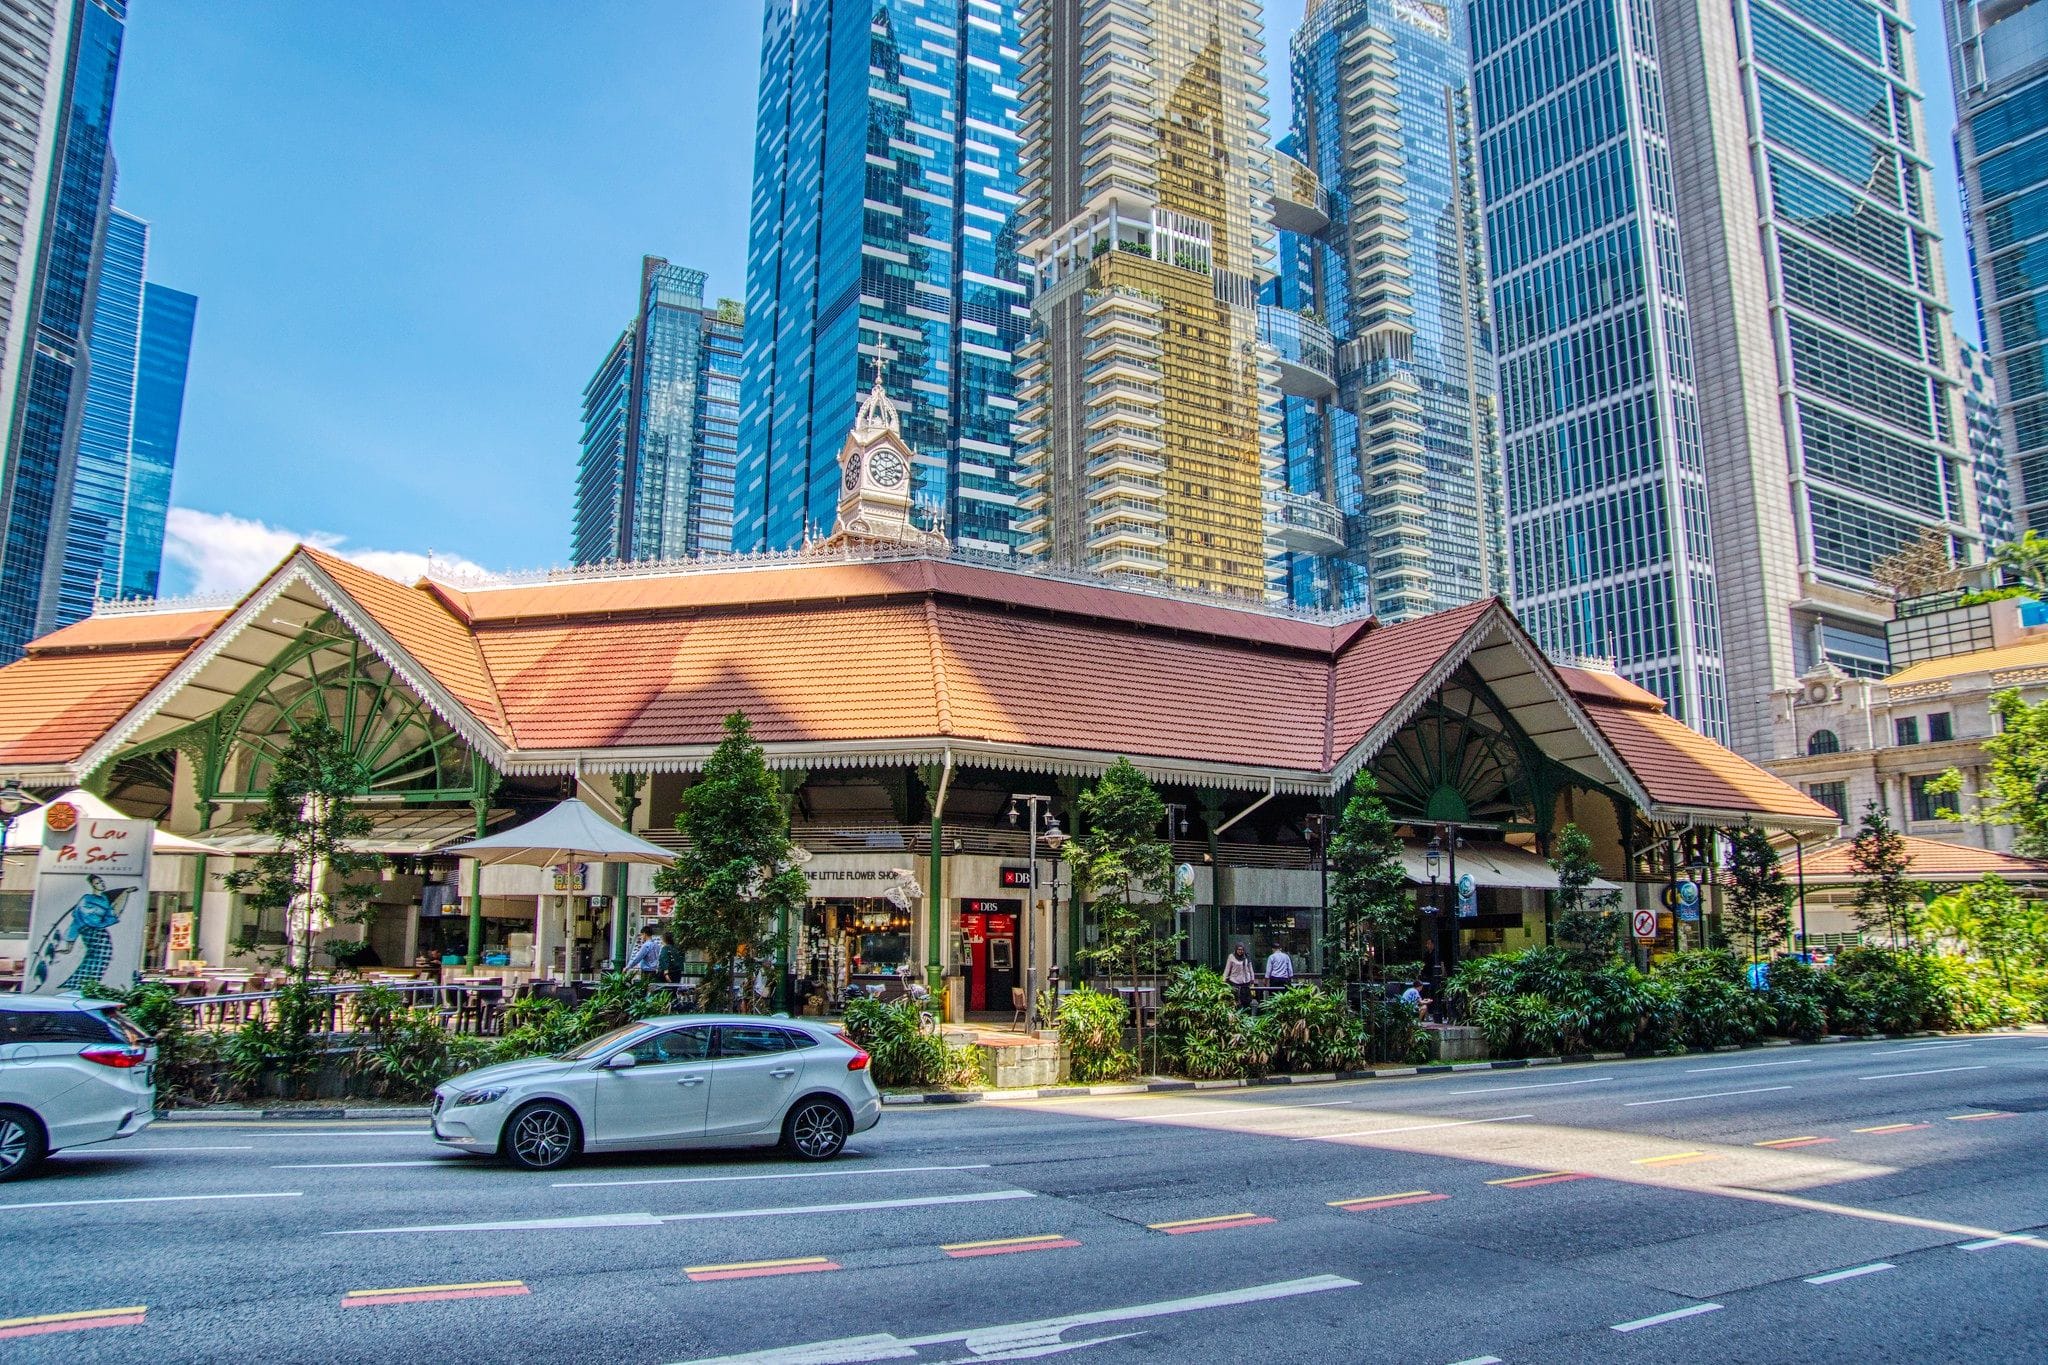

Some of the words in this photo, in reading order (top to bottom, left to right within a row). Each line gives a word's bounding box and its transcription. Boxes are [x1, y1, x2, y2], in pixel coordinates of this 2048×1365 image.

[90, 821, 128, 840] Lau
[57, 845, 78, 863] Pa
[85, 846, 129, 865] Sat
[804, 871, 817, 880] THE
[819, 871, 845, 880] LITTLE
[846, 871, 875, 880] FLOWER
[878, 871, 898, 880] SHOP
[1015, 872, 1030, 884] DB
[980, 902, 998, 911] DBS
